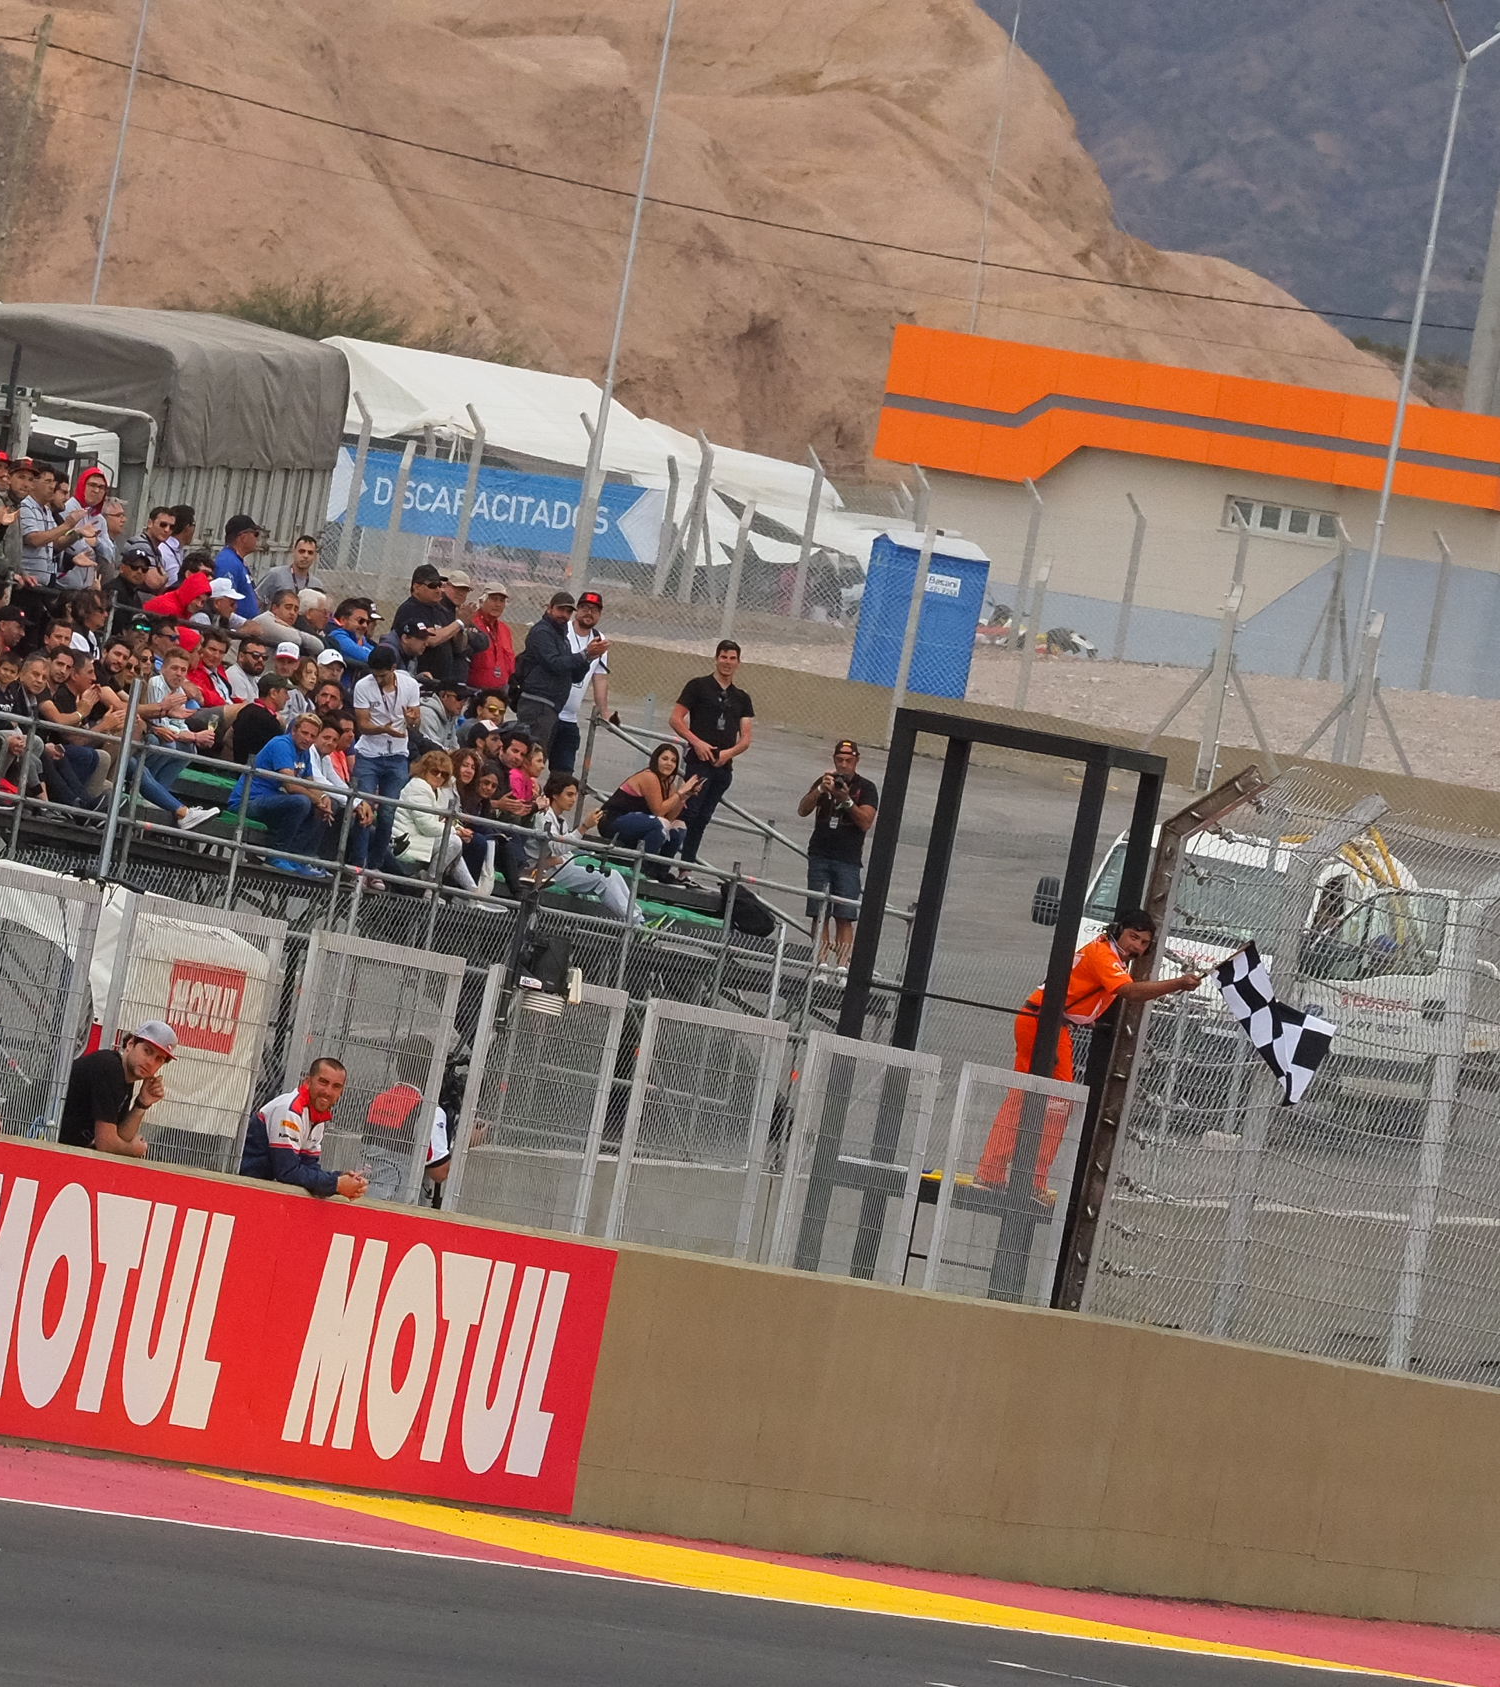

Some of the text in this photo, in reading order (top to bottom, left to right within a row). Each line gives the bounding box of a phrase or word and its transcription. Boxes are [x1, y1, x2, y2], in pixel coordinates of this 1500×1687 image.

[373, 477, 609, 535] DSCAPACITADS
[168, 978, 238, 1036] MOTUL
[281, 1232, 570, 1478] MOTUL
